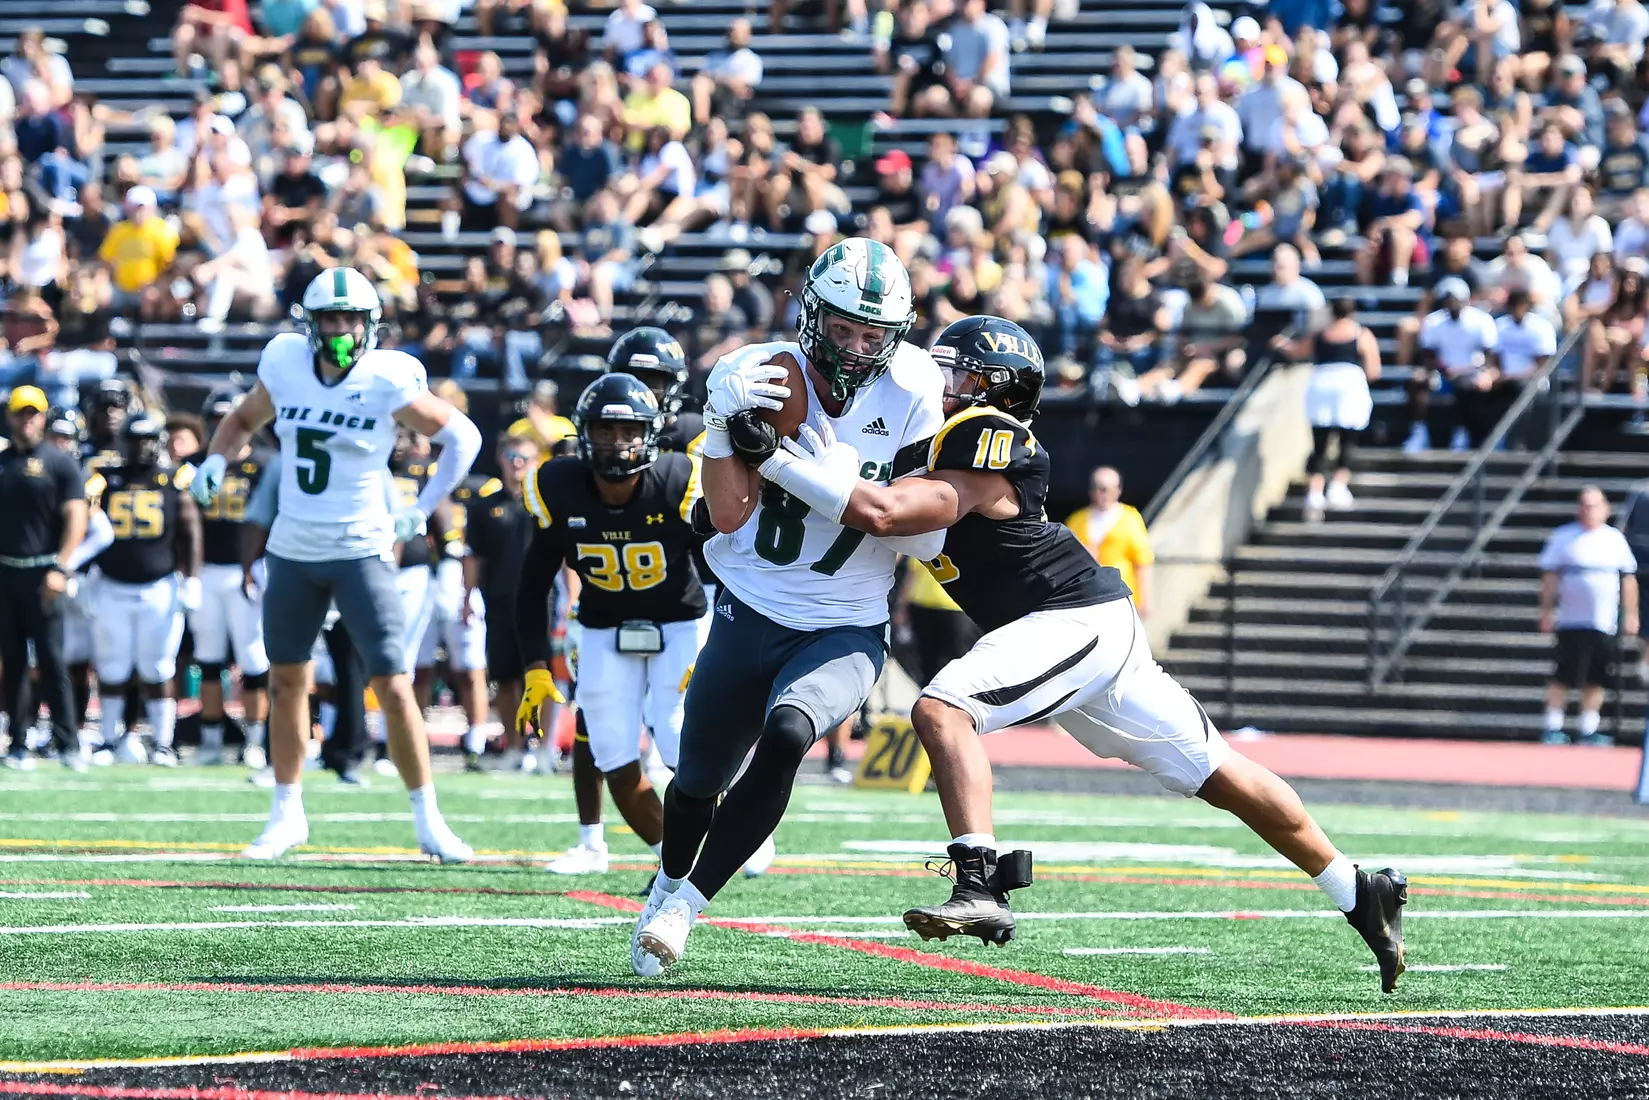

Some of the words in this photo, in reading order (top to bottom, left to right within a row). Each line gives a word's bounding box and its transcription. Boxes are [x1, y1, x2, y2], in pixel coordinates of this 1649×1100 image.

[858, 303, 882, 315] ROCK
[981, 331, 1041, 367] VILLE
[281, 407, 312, 421] THE
[319, 411, 377, 431] ROCK
[861, 426, 889, 437] adidas
[296, 427, 337, 495] 5
[972, 427, 1015, 470] 10
[108, 491, 165, 539] 55
[602, 530, 632, 541] VILLE
[576, 541, 667, 591] 38
[863, 727, 920, 779] 20
